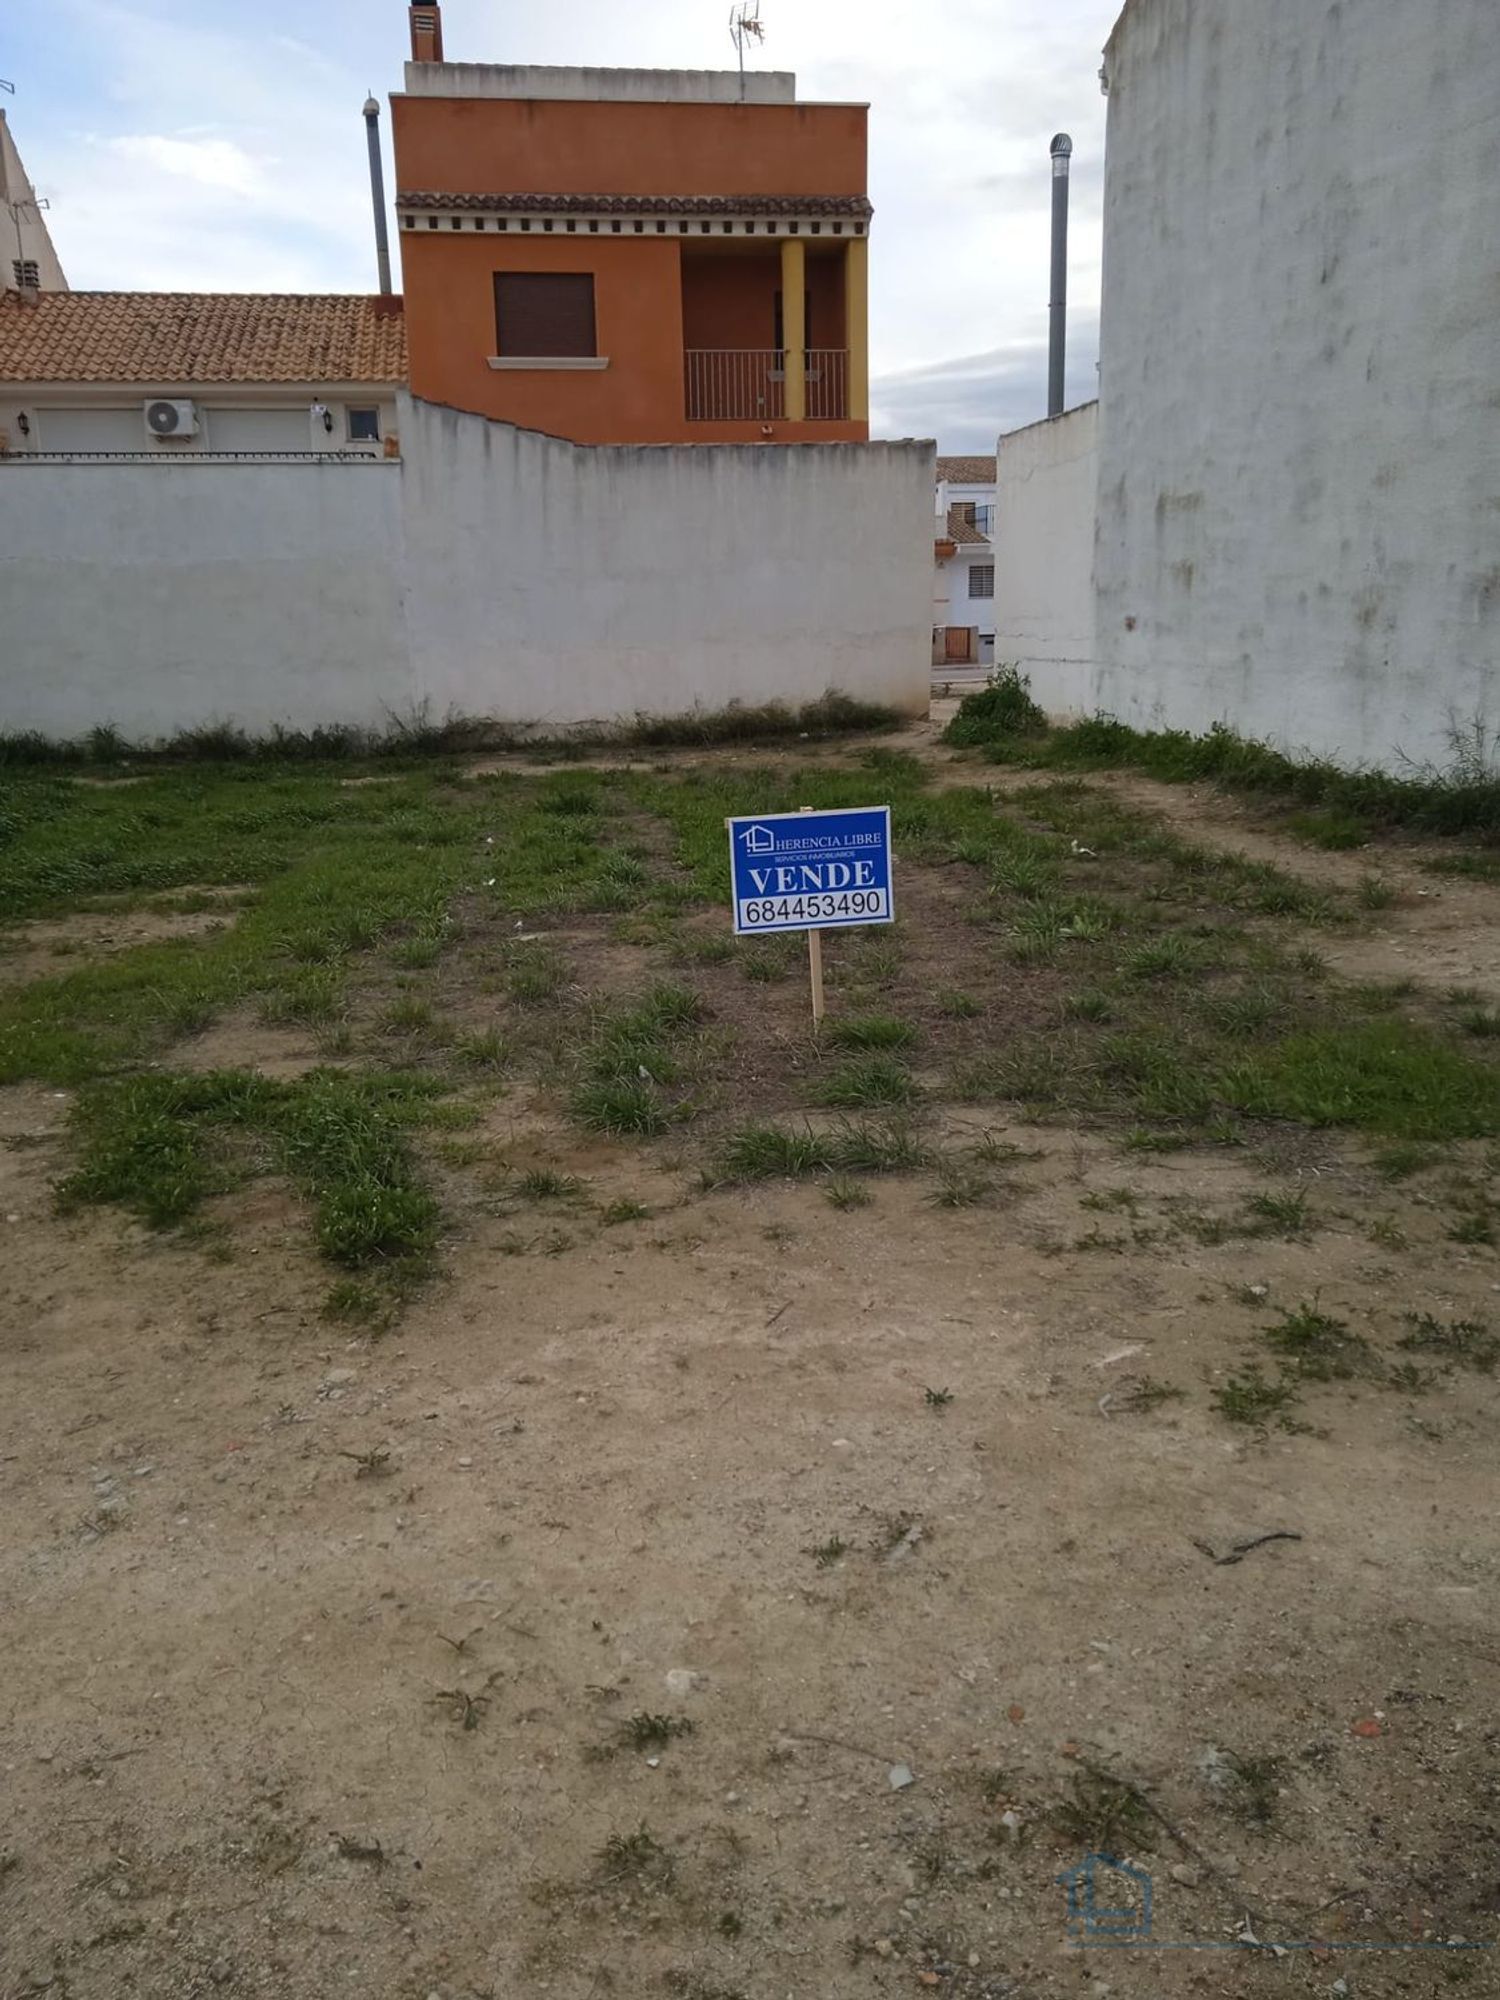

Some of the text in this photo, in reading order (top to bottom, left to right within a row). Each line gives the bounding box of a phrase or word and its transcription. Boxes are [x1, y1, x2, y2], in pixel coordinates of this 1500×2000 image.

[776, 833, 882, 851] HERENCIA LIBRE
[749, 861, 875, 894] VENDE
[746, 891, 880, 923] 684453490
